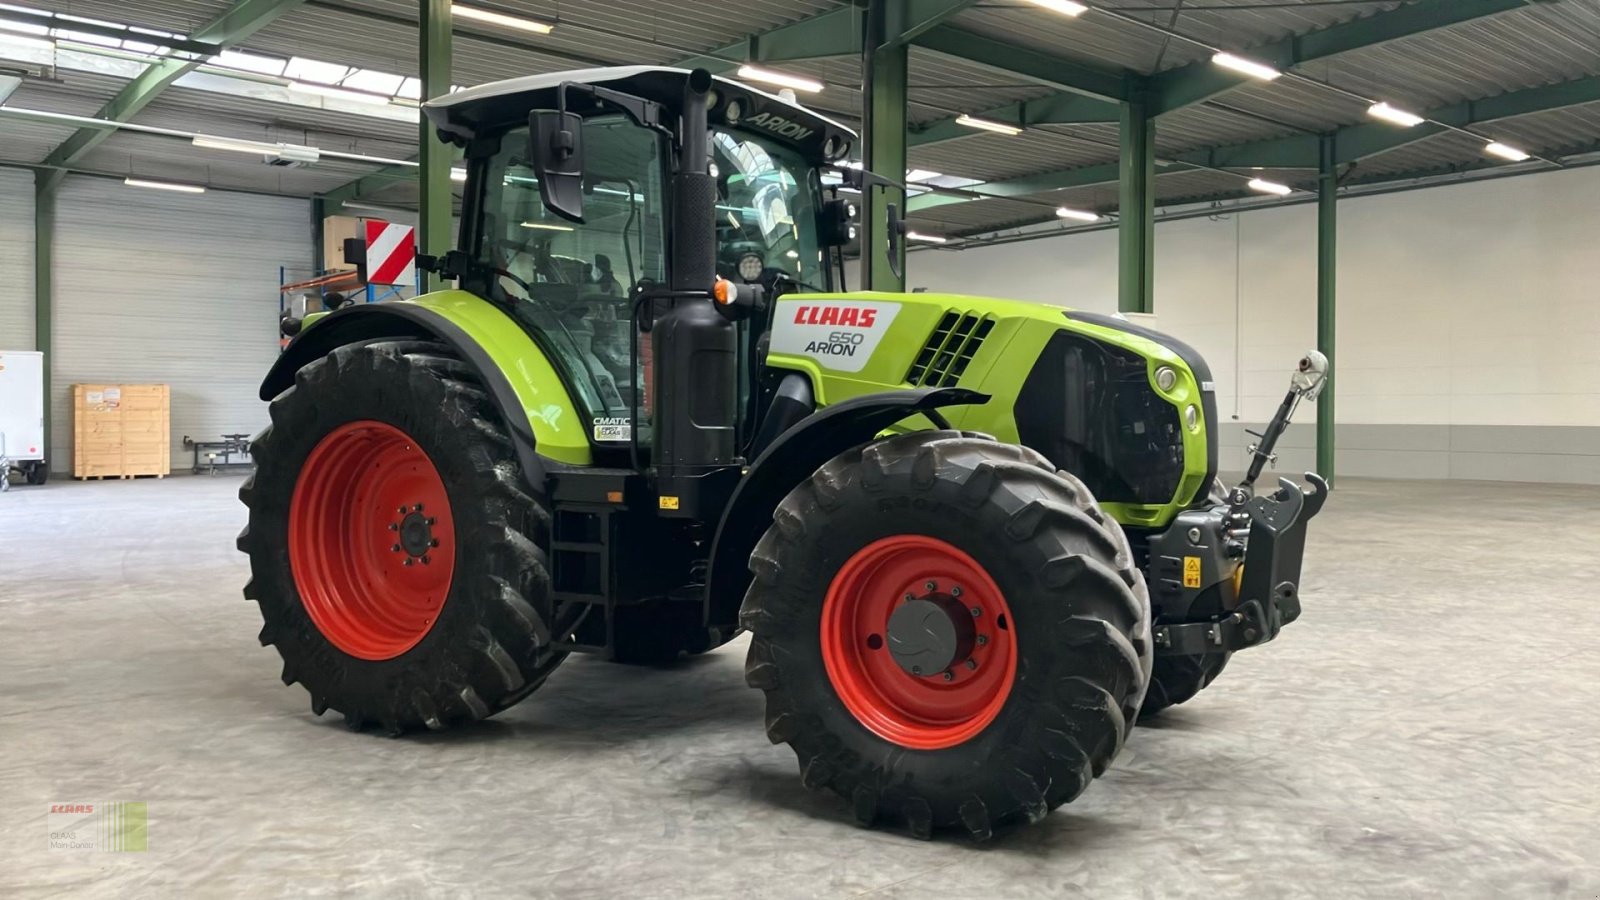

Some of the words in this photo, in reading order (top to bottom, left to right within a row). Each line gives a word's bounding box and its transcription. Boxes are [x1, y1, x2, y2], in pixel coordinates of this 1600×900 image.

[745, 112, 814, 140] ARION
[793, 306, 877, 328] CLAAS
[828, 331, 864, 345] 650
[804, 341, 856, 356] ARION
[593, 417, 631, 425] CMATIC
